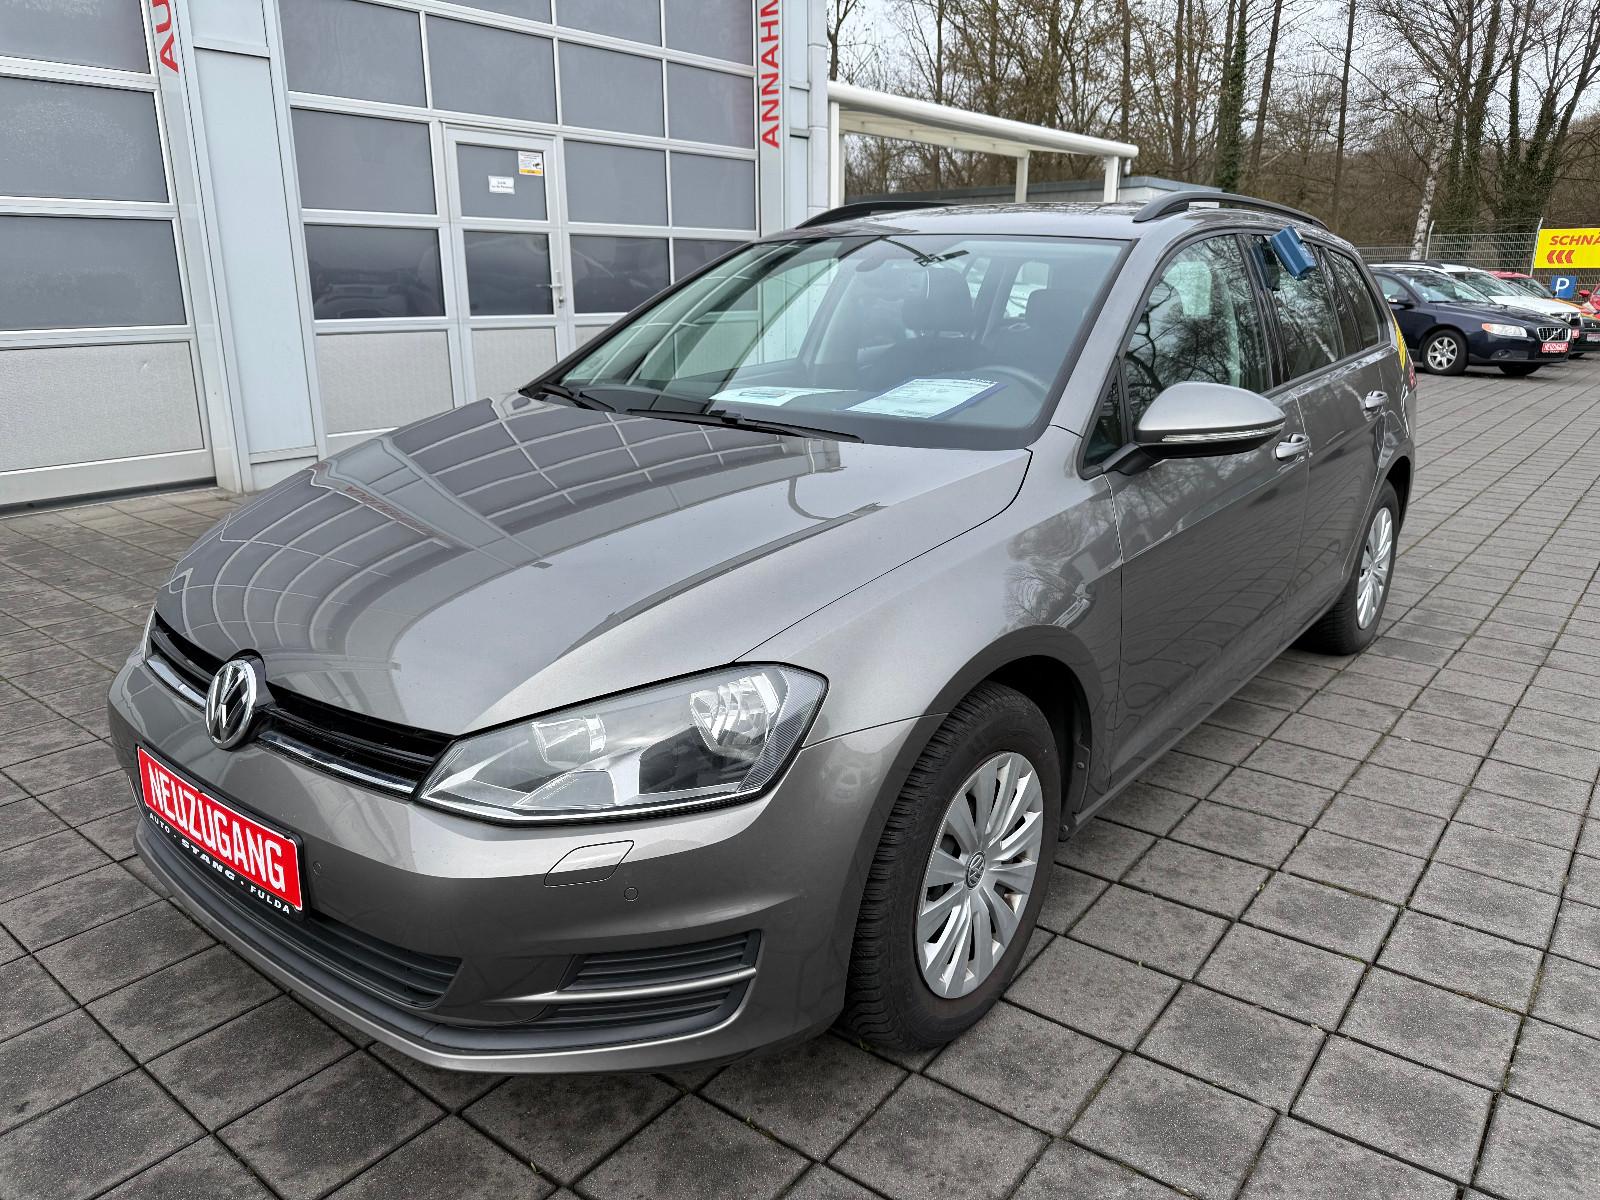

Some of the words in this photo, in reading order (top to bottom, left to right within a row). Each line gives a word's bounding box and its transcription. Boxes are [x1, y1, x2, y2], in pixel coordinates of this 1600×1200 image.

[1555, 277, 1570, 296] P
[147, 761, 286, 893] NEUZUGANG
[149, 812, 170, 834] AUTO
[181, 838, 236, 881] STANG
[250, 886, 290, 914] FULDA
